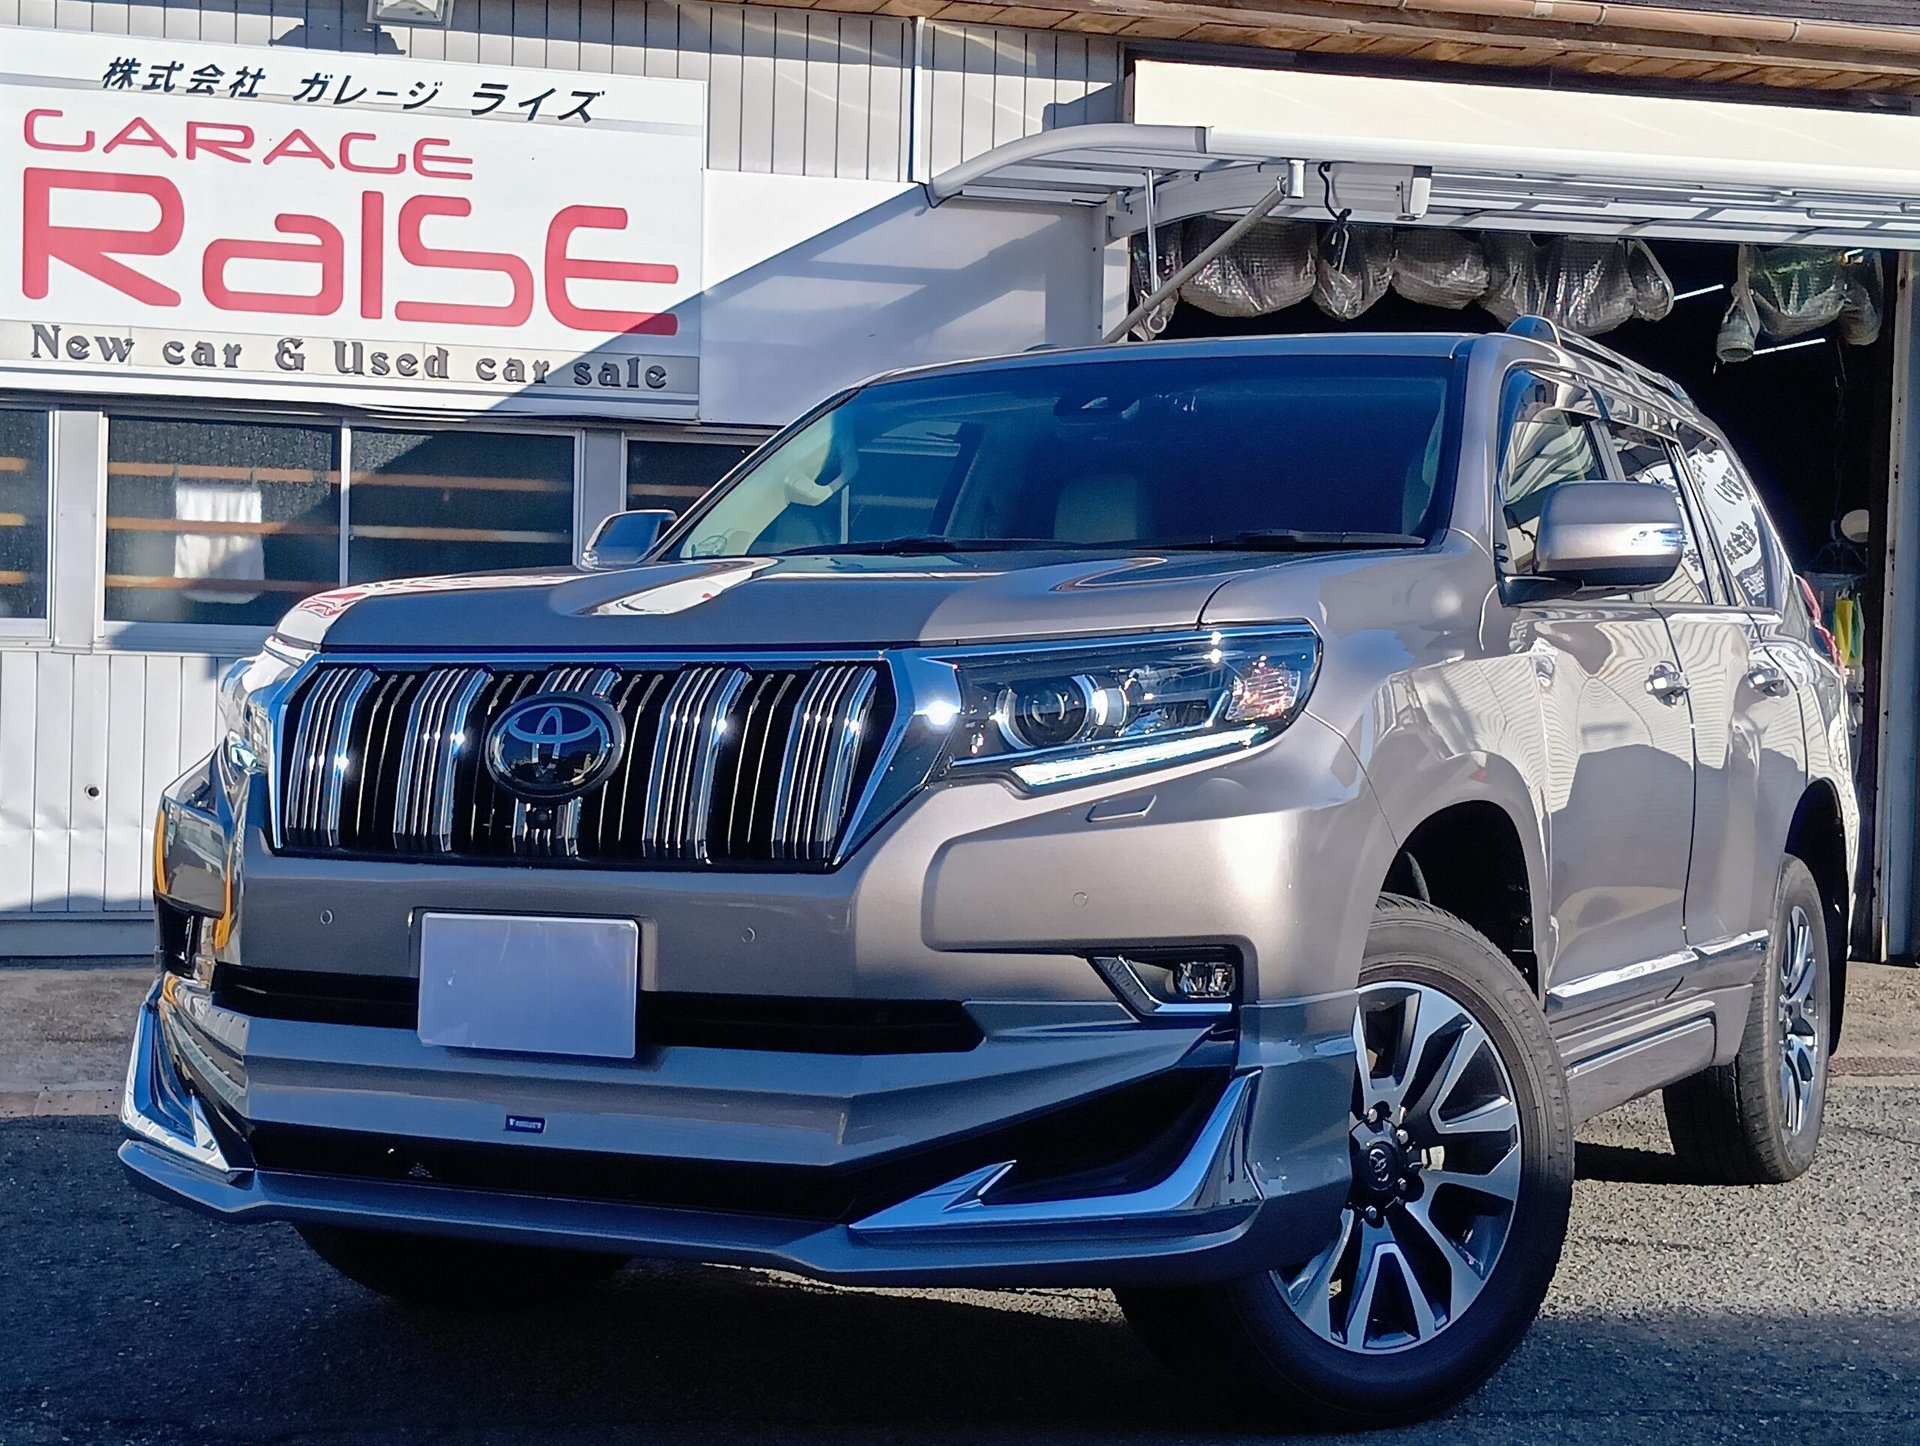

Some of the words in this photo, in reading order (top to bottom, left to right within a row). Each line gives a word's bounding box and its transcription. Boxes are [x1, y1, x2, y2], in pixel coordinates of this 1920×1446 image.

[102, 56, 266, 98] 株式会社
[293, 72, 442, 112] ガレージ
[471, 82, 606, 124] ライズ
[23, 108, 473, 180] GARAGE
[31, 324, 134, 363] New
[162, 341, 242, 369] car
[274, 337, 306, 372] &
[333, 340, 450, 380] Used
[475, 357, 550, 387] car
[573, 356, 667, 390] sale
